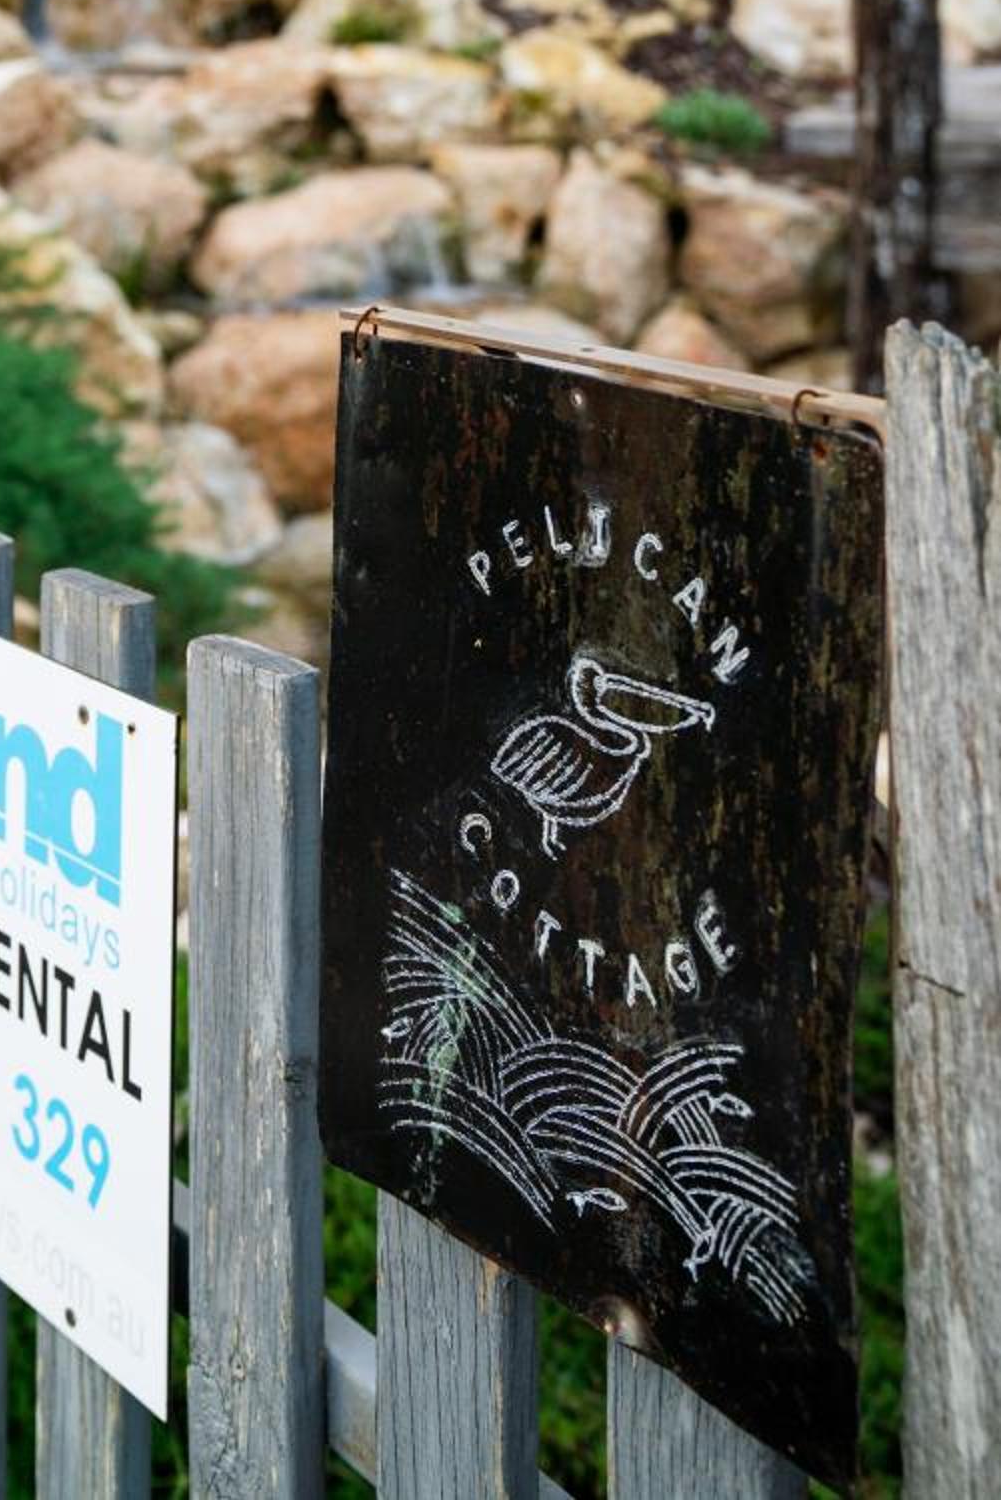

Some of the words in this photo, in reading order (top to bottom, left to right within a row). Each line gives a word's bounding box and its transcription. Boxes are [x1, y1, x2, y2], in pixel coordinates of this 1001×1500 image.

[467, 502, 750, 684] PELICAN
[459, 812, 737, 1008] COTTAGE
[12, 1073, 111, 1211] 329
